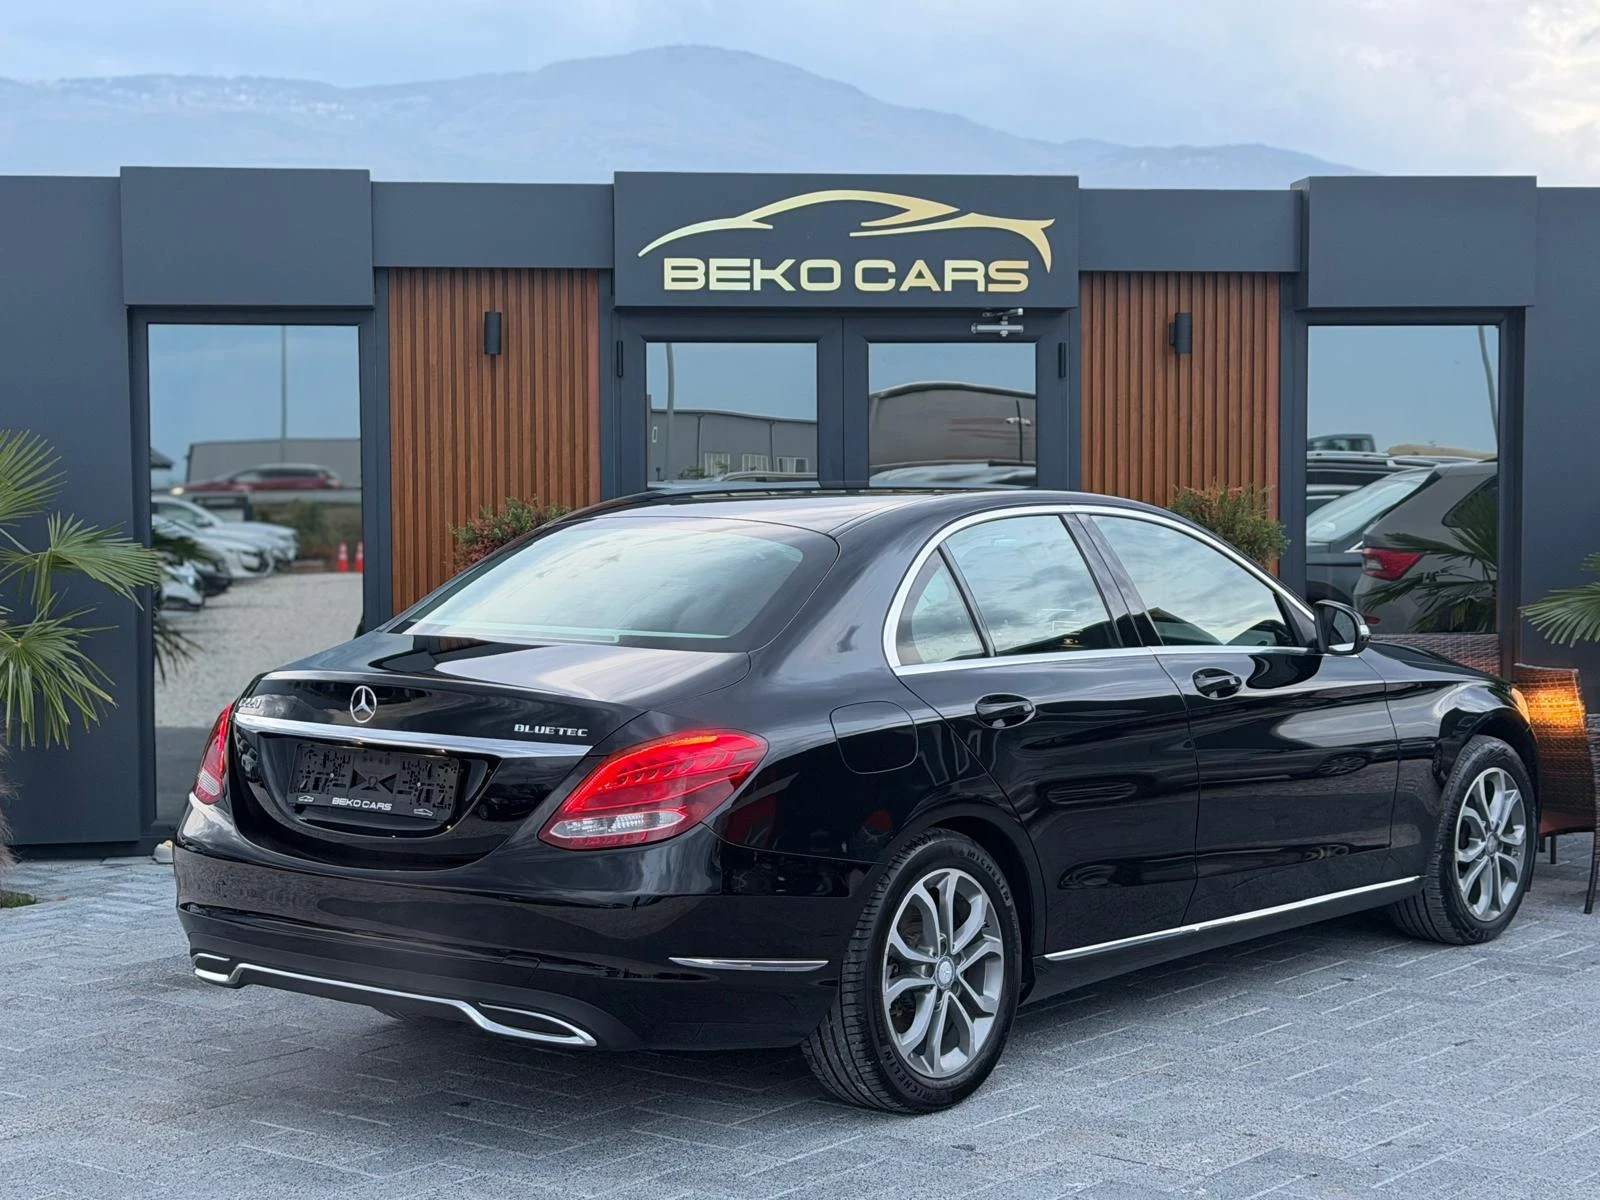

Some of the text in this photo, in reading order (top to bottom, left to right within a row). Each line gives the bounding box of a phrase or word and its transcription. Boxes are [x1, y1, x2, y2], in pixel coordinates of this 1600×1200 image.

[664, 258, 1030, 292] BEKO CARS
[514, 723, 588, 737] BLUETEC
[331, 797, 393, 811] BEKO CARS
[967, 849, 1010, 901] MICHELIN
[884, 1049, 933, 1100] MICHELIN
